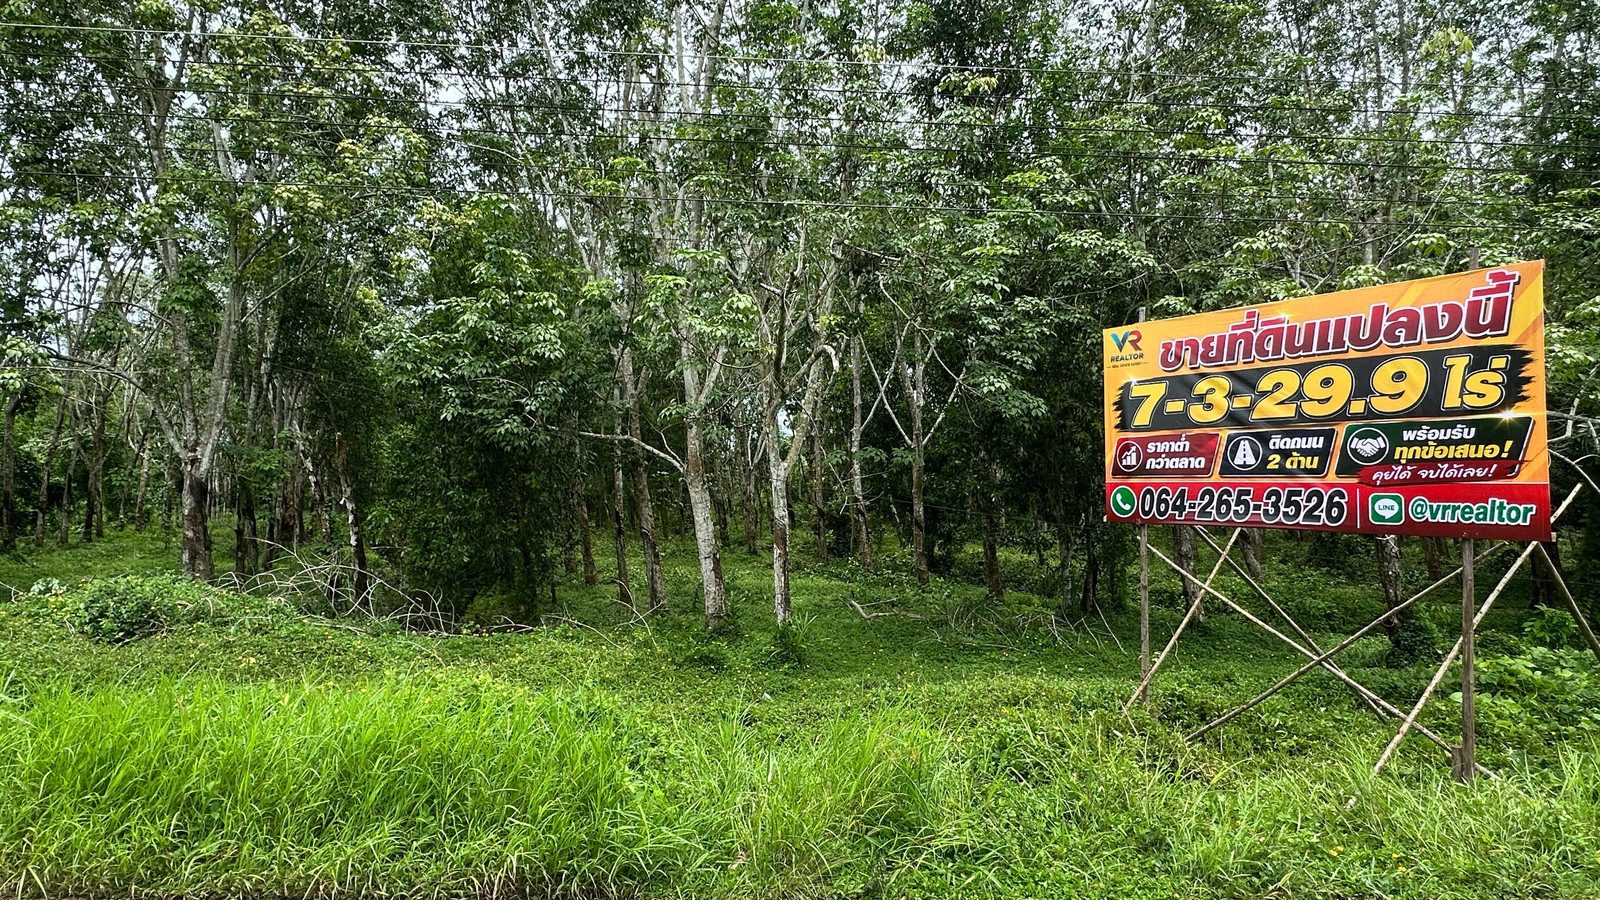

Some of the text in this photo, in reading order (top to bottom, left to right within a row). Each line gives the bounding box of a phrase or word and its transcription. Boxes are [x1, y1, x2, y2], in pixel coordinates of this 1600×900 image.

[1159, 270, 1519, 371] ขายที่ดินแปลงนี้
[1111, 330, 1142, 352] VR
[1110, 352, 1144, 362] REALTOR
[1130, 354, 1510, 428] 7-3-29.9 ไร่
[1269, 434, 1324, 449] ติดถนน
[1402, 424, 1476, 441] พร้อมรับ
[1146, 434, 1190, 453] ราคาต่ำ
[1146, 454, 1206, 470] กว่าตลาด
[1266, 452, 1318, 470] 2 ด้าน
[1372, 464, 1418, 486] คุยได้
[1139, 486, 1348, 526] 064-265-3526
[1409, 496, 1536, 525] @vrrealtor
